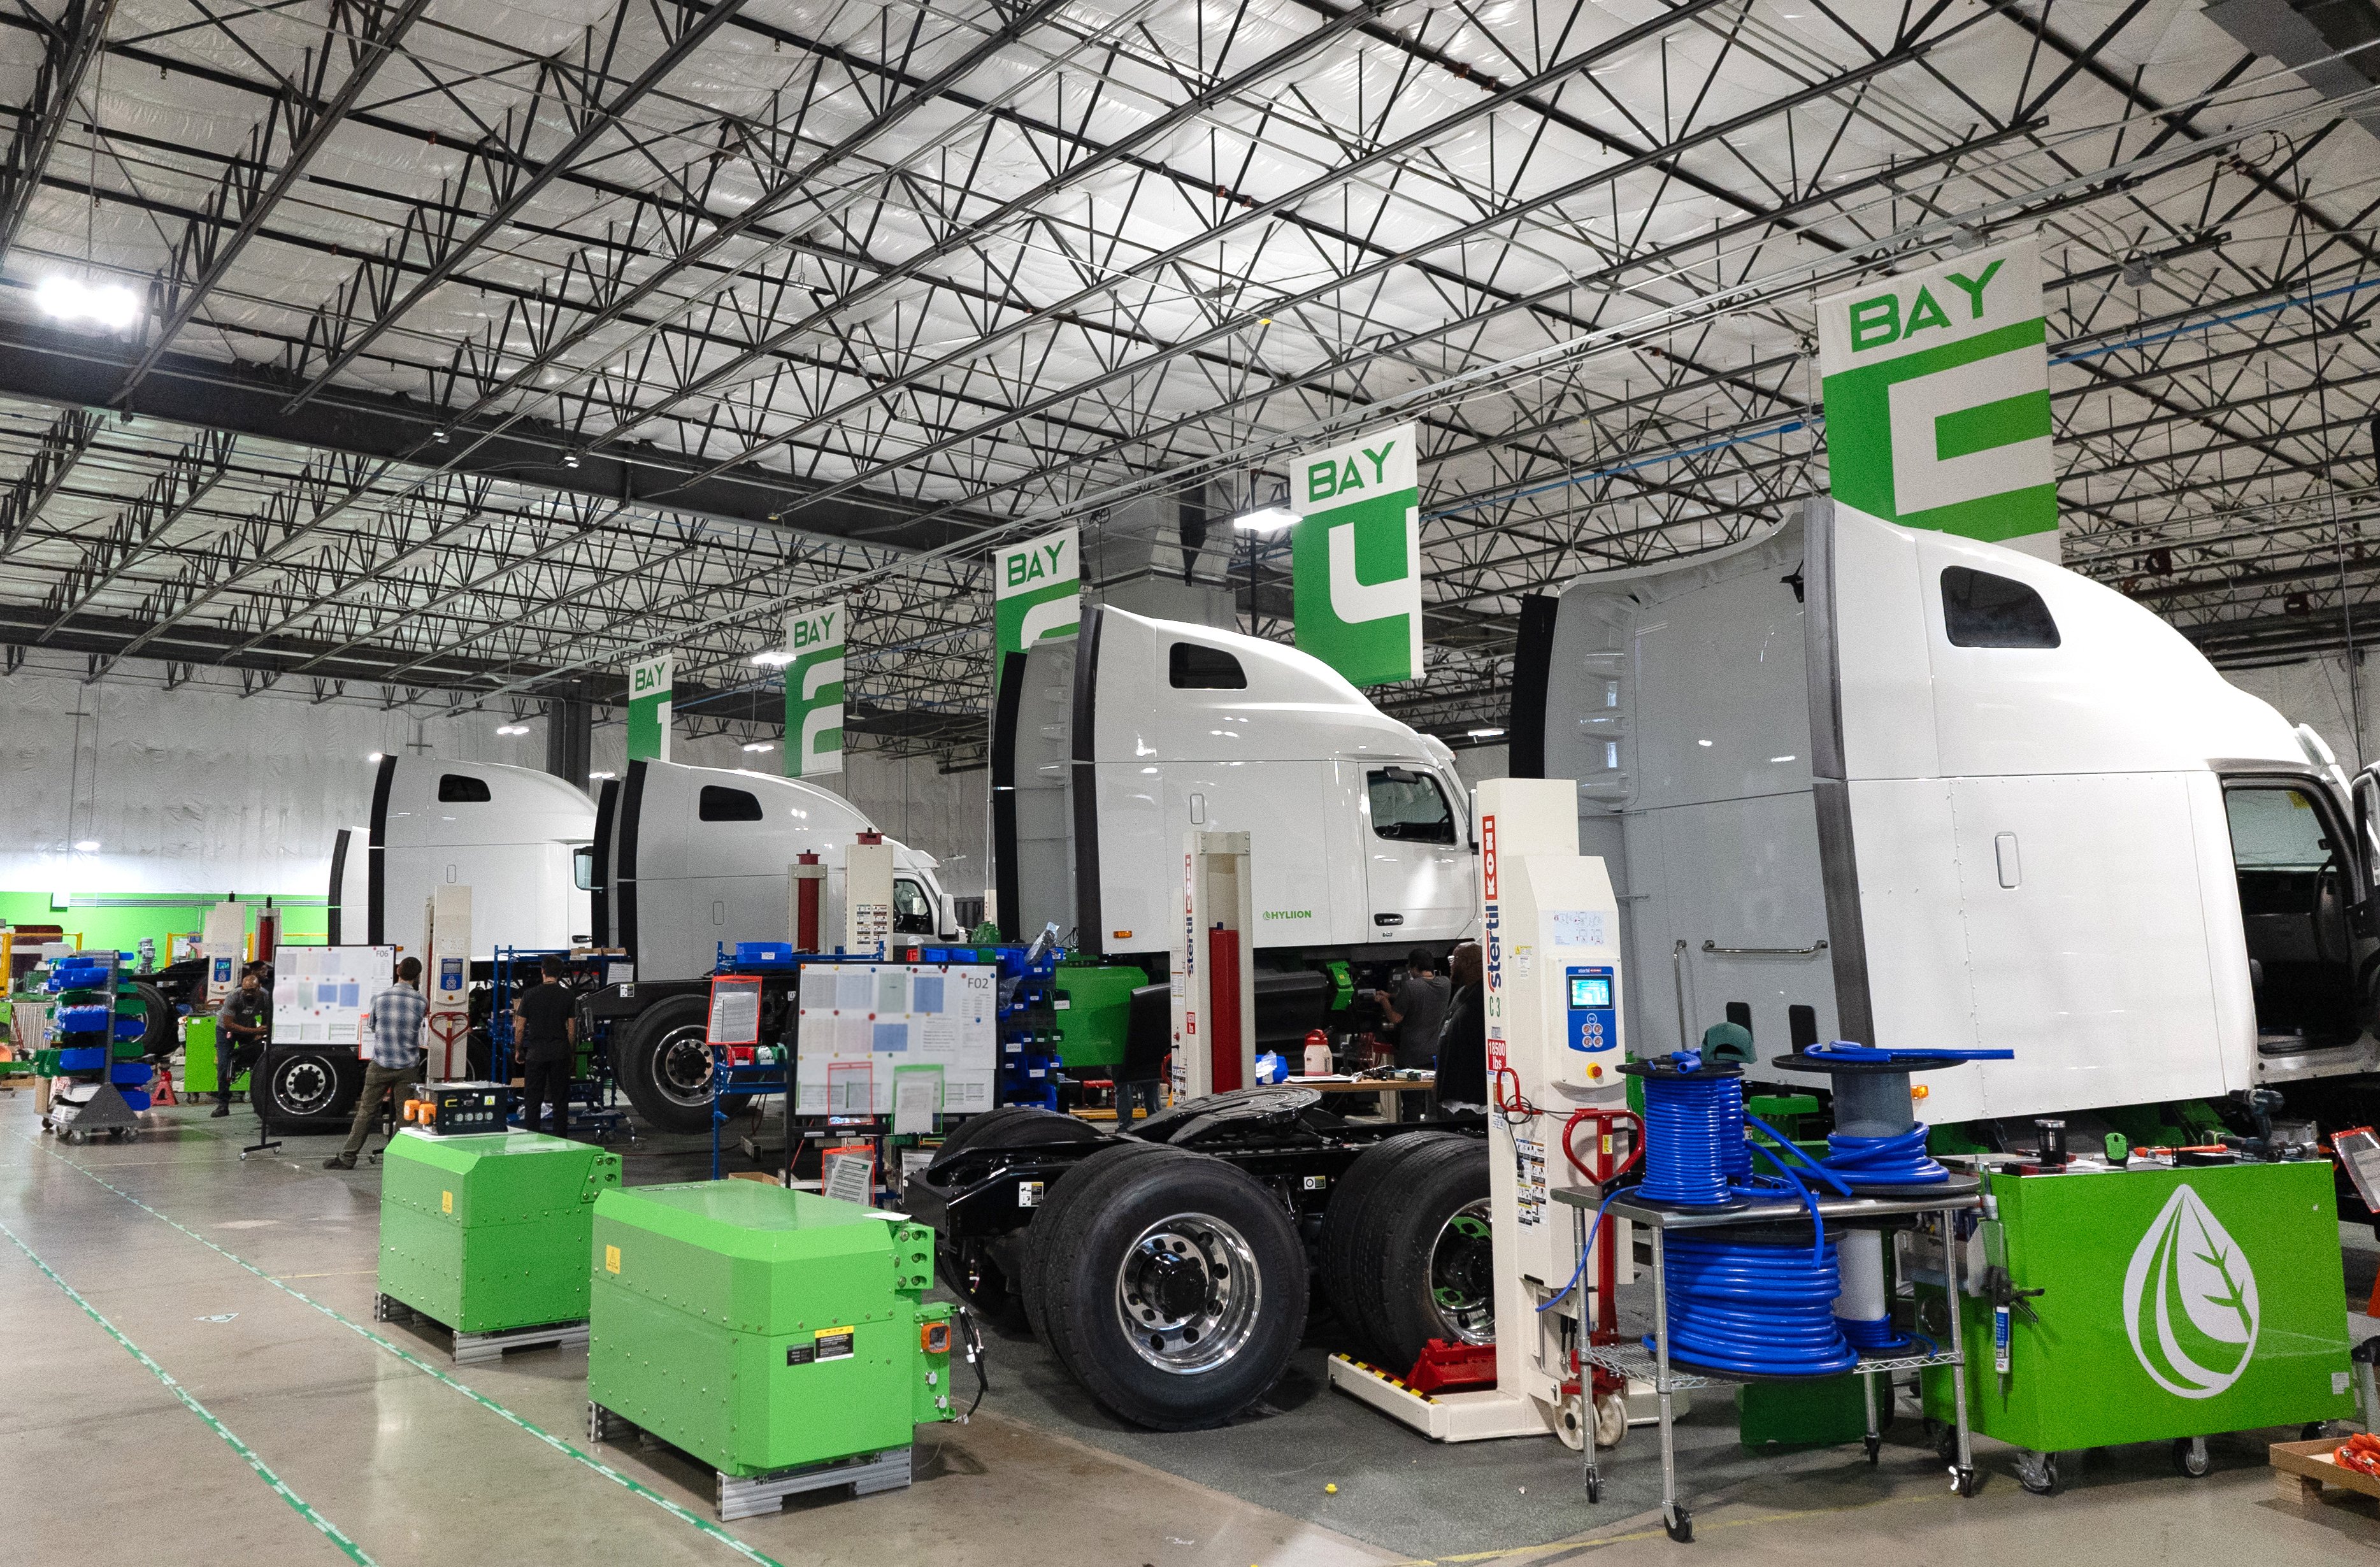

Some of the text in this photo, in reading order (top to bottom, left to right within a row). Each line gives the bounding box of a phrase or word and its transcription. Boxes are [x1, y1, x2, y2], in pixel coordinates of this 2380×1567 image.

[1849, 258, 2007, 353] BAY
[1308, 440, 1396, 503] BAY
[1007, 540, 1066, 587] BAY
[1328, 505, 1424, 679] 4
[794, 612, 836, 648] BAY
[634, 661, 666, 692] BAY
[657, 700, 672, 763] 1
[801, 657, 844, 776] 2
[1271, 910, 1312, 919] HYLIION
[1484, 820, 1501, 991] stertil KONI
[1186, 916, 1194, 977] stertil
[968, 977, 989, 989] F02
[1488, 1041, 1505, 1057] 18500
[1493, 1056, 1502, 1070] lbs
